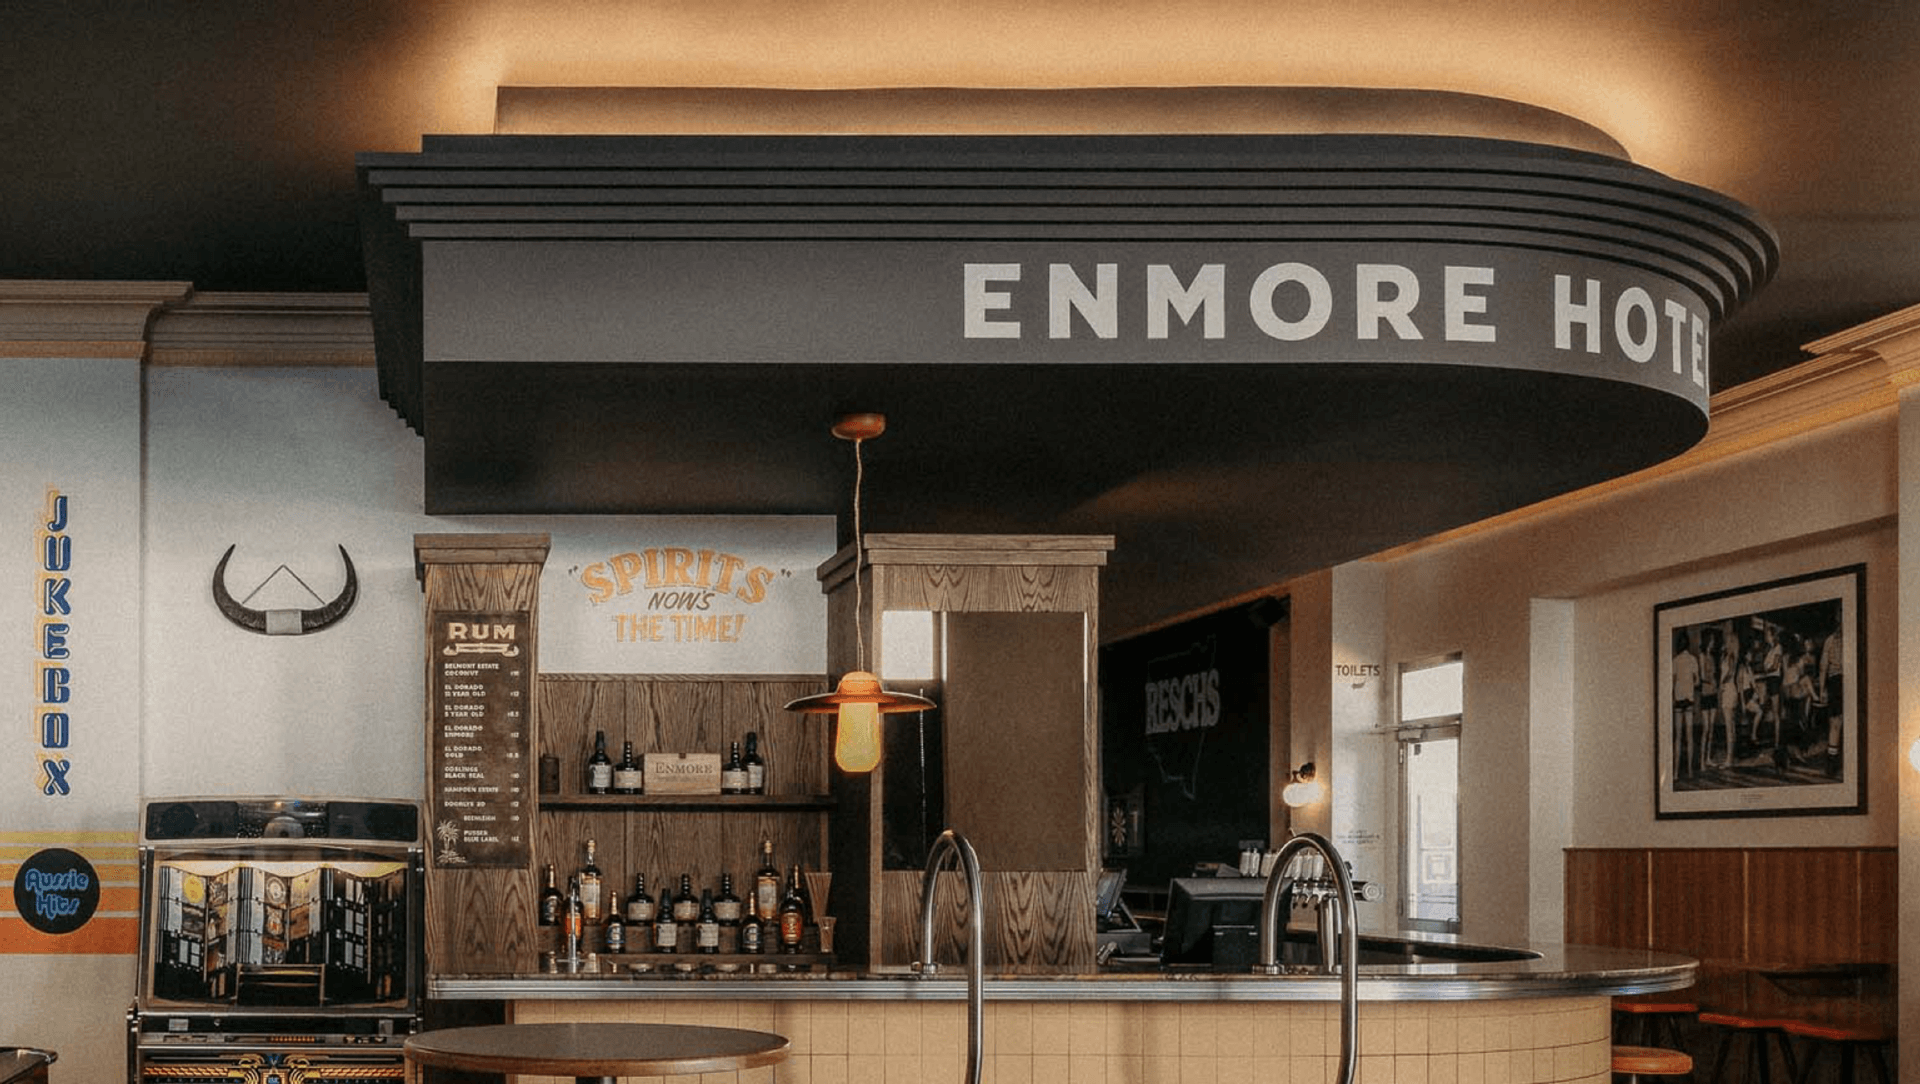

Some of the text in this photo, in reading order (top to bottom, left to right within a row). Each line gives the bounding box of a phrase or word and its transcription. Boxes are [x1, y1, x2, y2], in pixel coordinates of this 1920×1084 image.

[963, 263, 1497, 343] ENMORE
[648, 590, 715, 611] NOW'S
[449, 622, 516, 640] RUM
[612, 613, 748, 643] THE TIME!
[39, 491, 72, 796] JUKEBOX
[1335, 664, 1380, 676] TOILETS
[1145, 668, 1220, 734] RESCHS
[655, 763, 713, 774] ENMORE
[25, 868, 89, 891] Aussie
[36, 893, 80, 920] Hits
